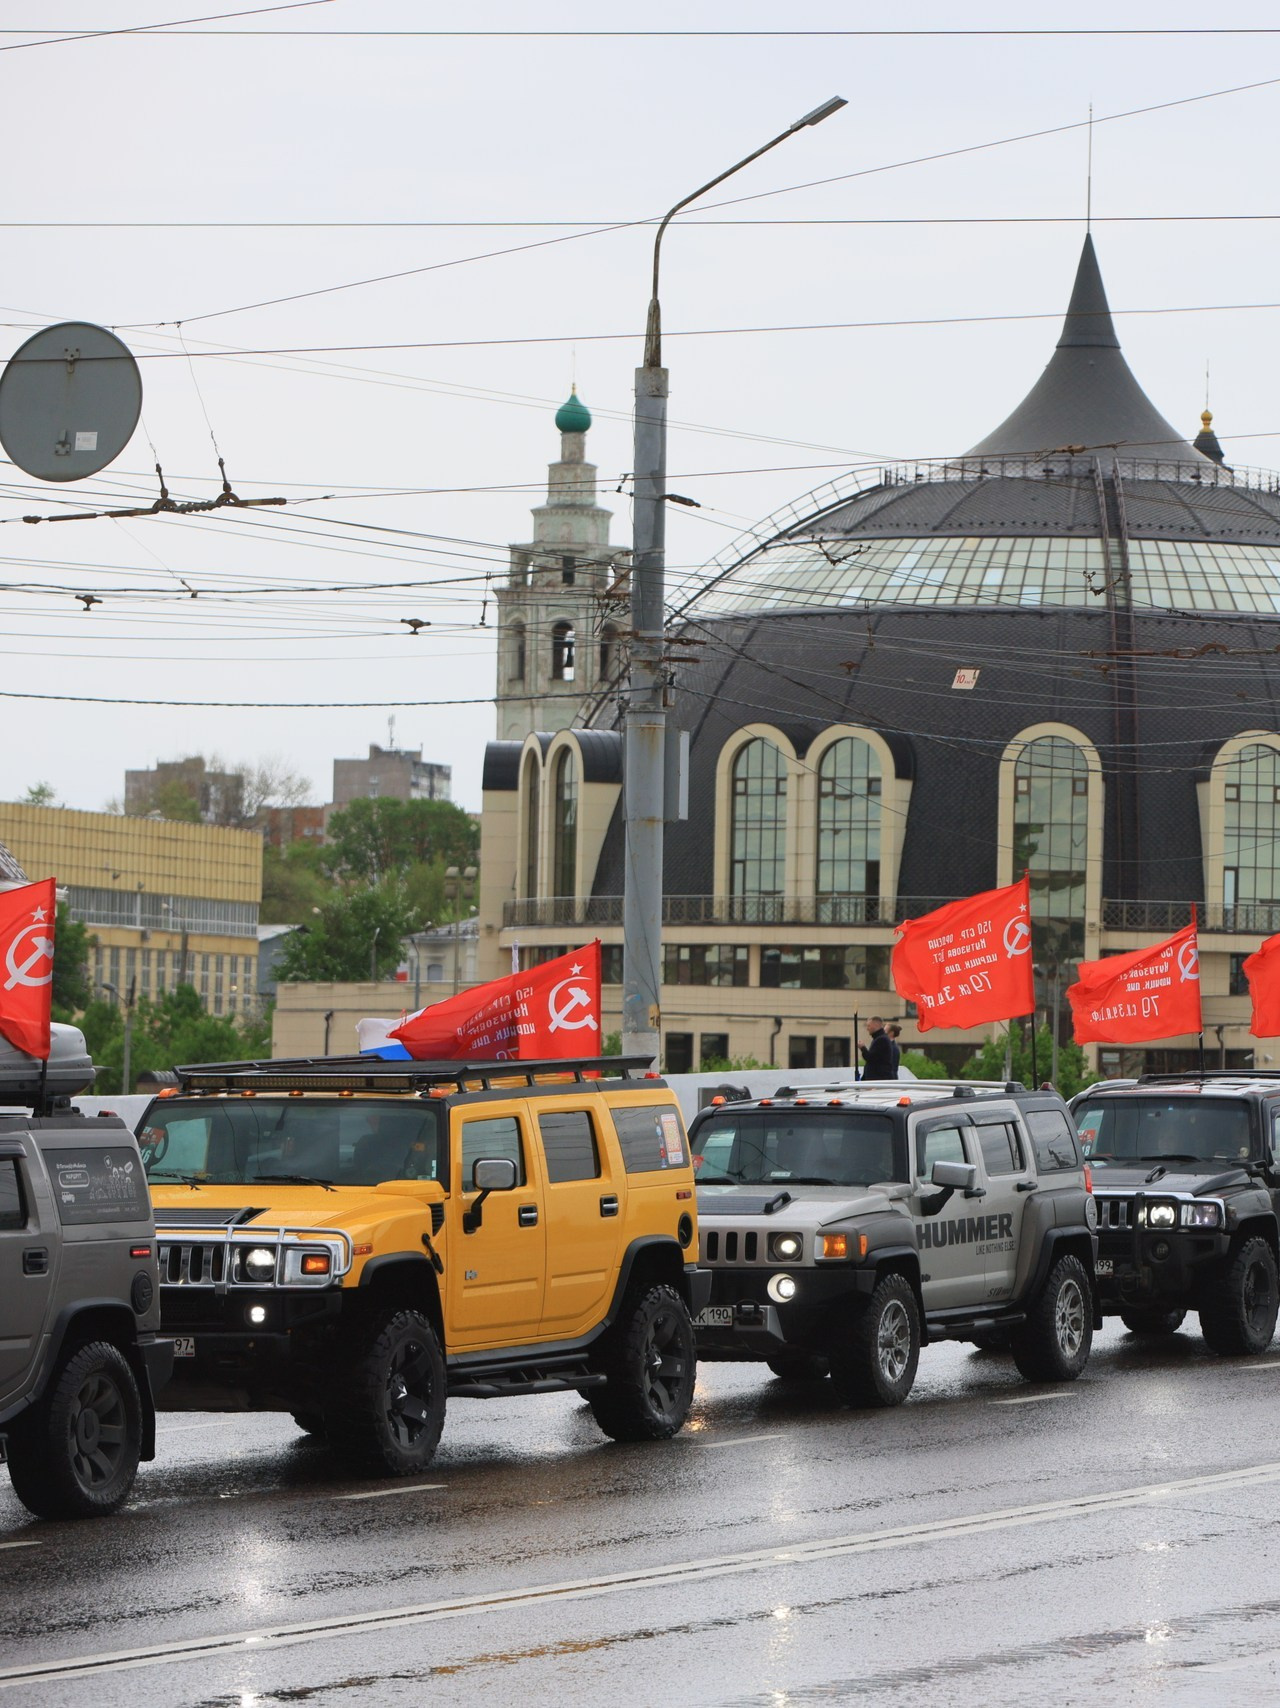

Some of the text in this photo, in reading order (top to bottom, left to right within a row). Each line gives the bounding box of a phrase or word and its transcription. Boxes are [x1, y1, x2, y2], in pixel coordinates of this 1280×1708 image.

[139, 1147, 152, 1164] 16
[1082, 1145, 1091, 1156] 18
[916, 1213, 1013, 1250] HUMMER
[710, 1308, 729, 1320] 190
[175, 1338, 190, 1351] 97
